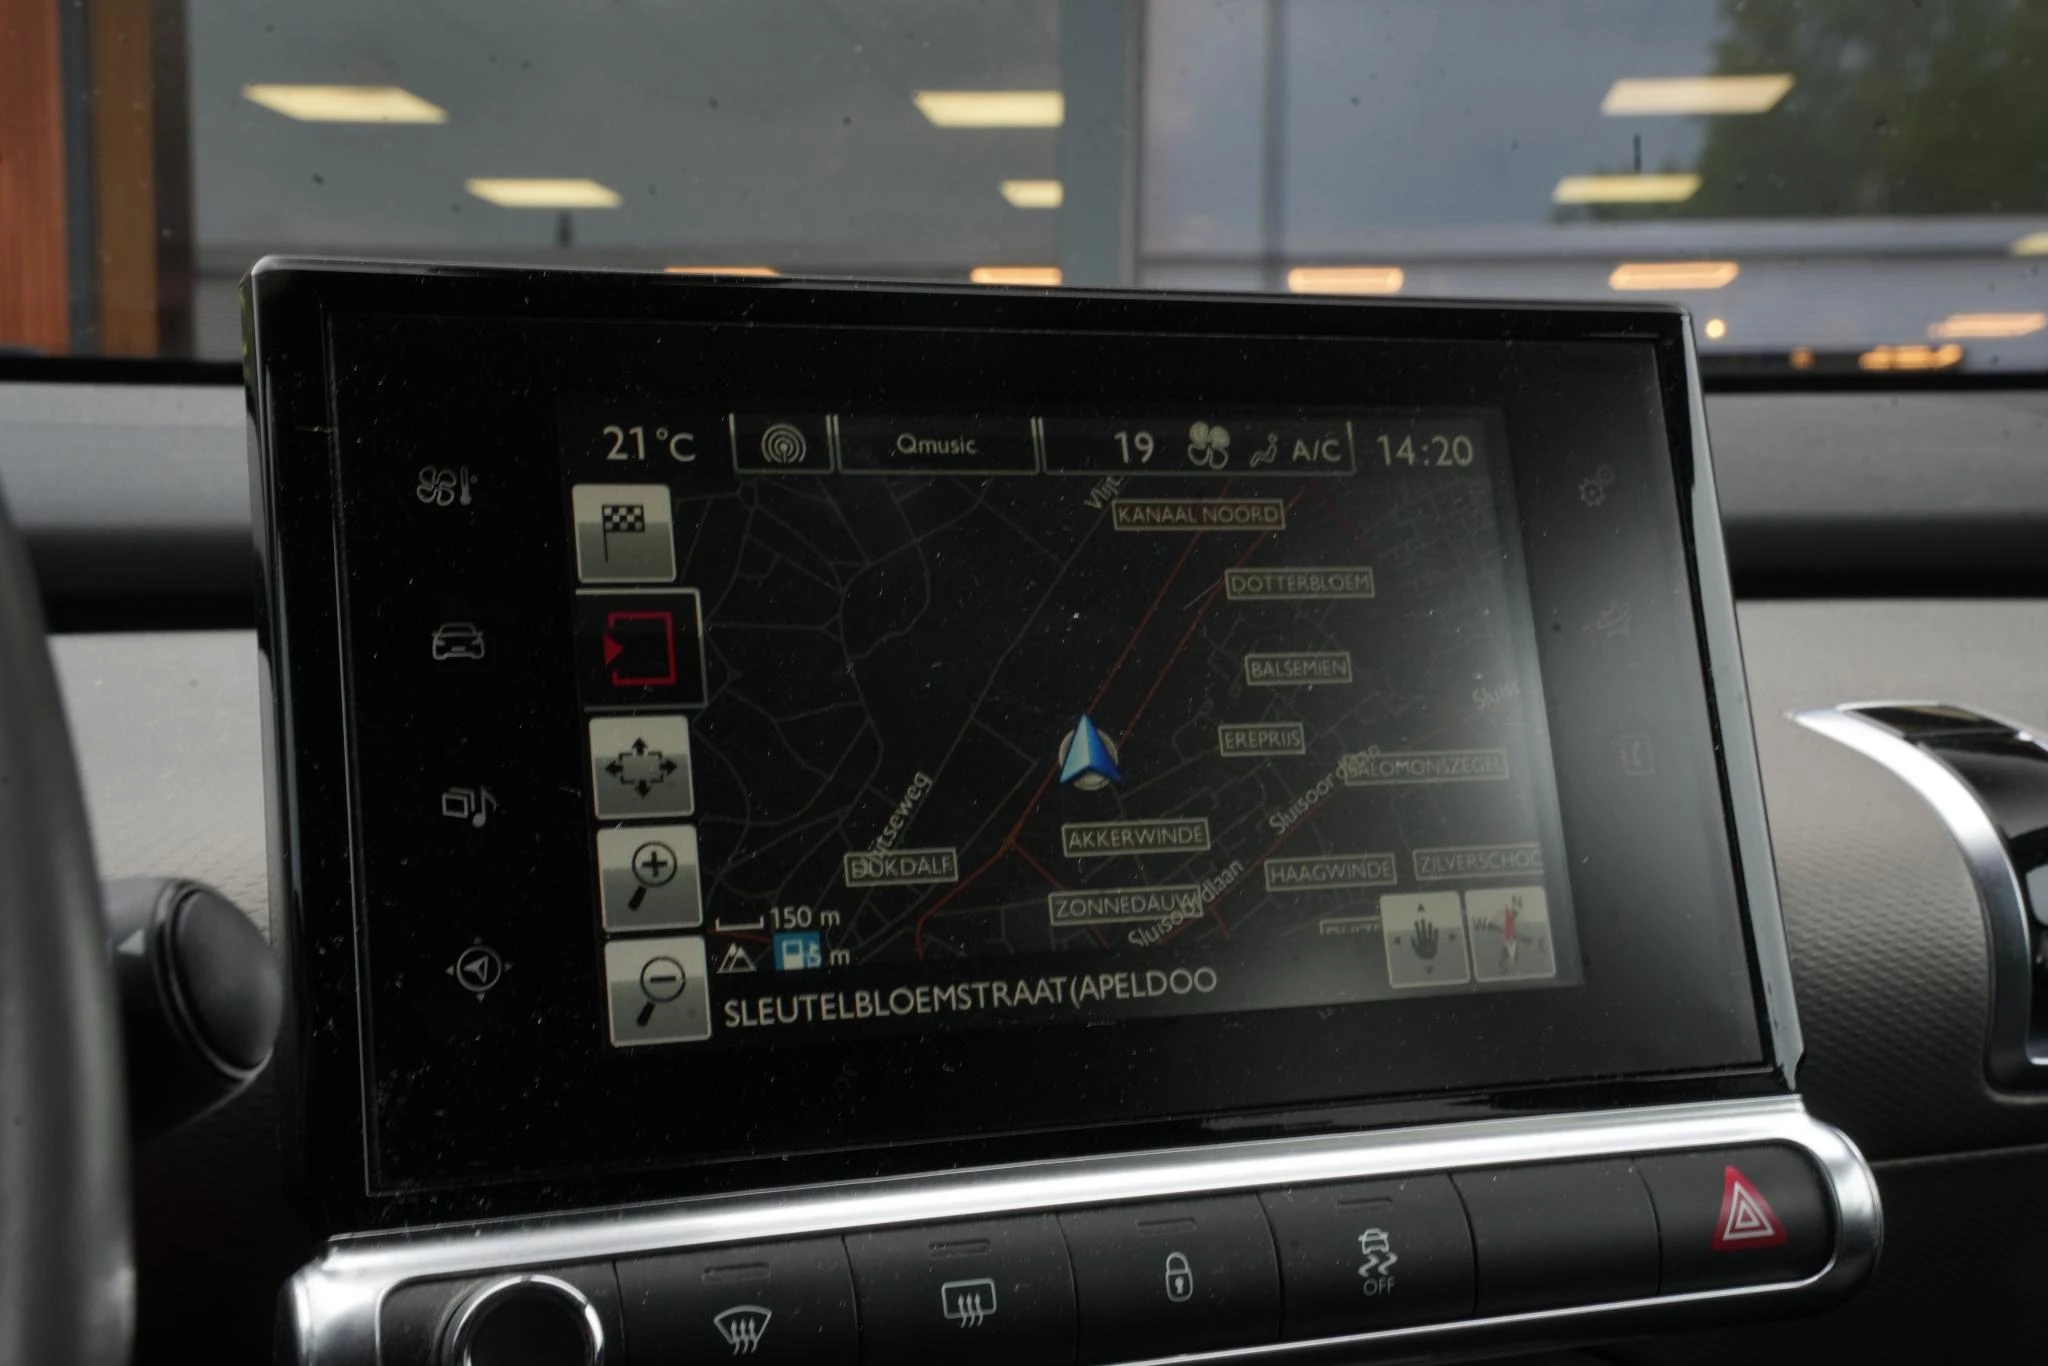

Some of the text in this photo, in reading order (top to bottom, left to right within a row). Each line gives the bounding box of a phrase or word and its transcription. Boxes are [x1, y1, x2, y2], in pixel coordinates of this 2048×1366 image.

[896, 432, 977, 456] Qmusic
[1113, 430, 1155, 465] 19
[1291, 439, 1342, 463] A/C
[1375, 434, 1475, 467] 14:20
[1117, 505, 1279, 524] KANAAL NOORD
[1230, 573, 1371, 594] DOTTERBLOEM
[1250, 659, 1348, 679] BALSEMIEN
[1224, 730, 1302, 750] EREPRIJS
[1067, 826, 1204, 850] AKKERWINDE
[1270, 862, 1392, 885] HAAGWINDE
[770, 904, 842, 930] 150 m
[829, 948, 852, 967] m
[1363, 1276, 1397, 1297] OFF
